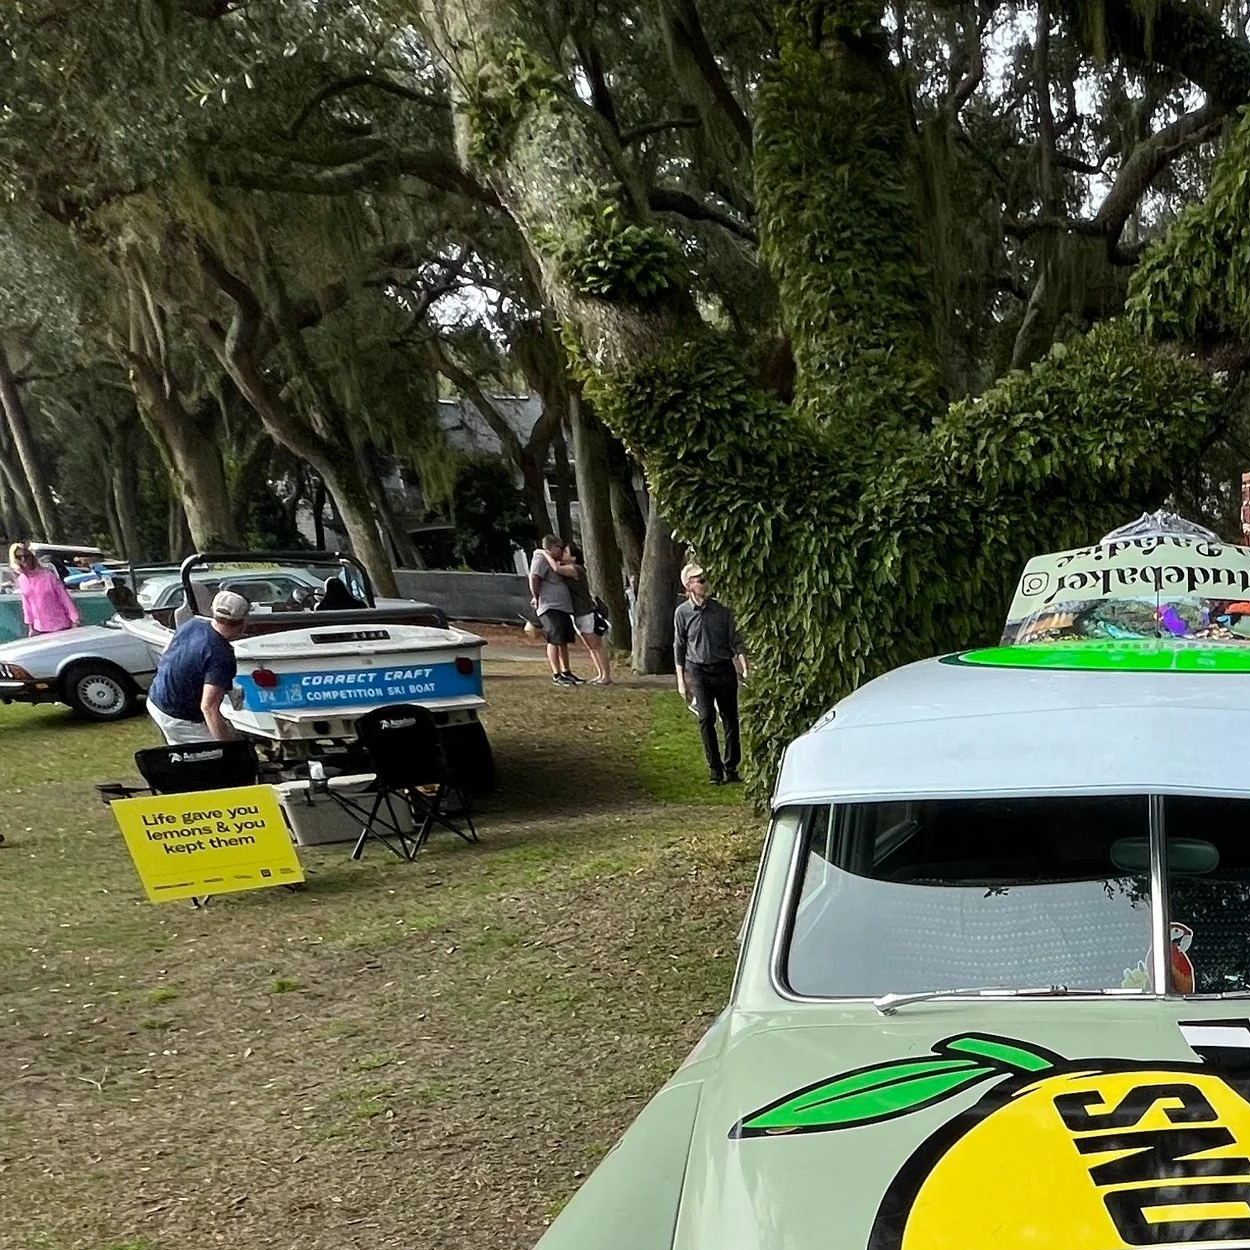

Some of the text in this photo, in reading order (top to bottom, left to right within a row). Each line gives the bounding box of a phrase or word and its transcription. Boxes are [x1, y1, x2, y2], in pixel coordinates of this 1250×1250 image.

[301, 668, 433, 686] CORRECT CRAFT
[306, 688, 383, 701] COMPETITION
[387, 685, 406, 697] SKI
[409, 682, 436, 694] BOAT
[141, 805, 259, 826] Life gave you
[145, 819, 266, 841] lemons & you
[163, 834, 256, 855] kept them
